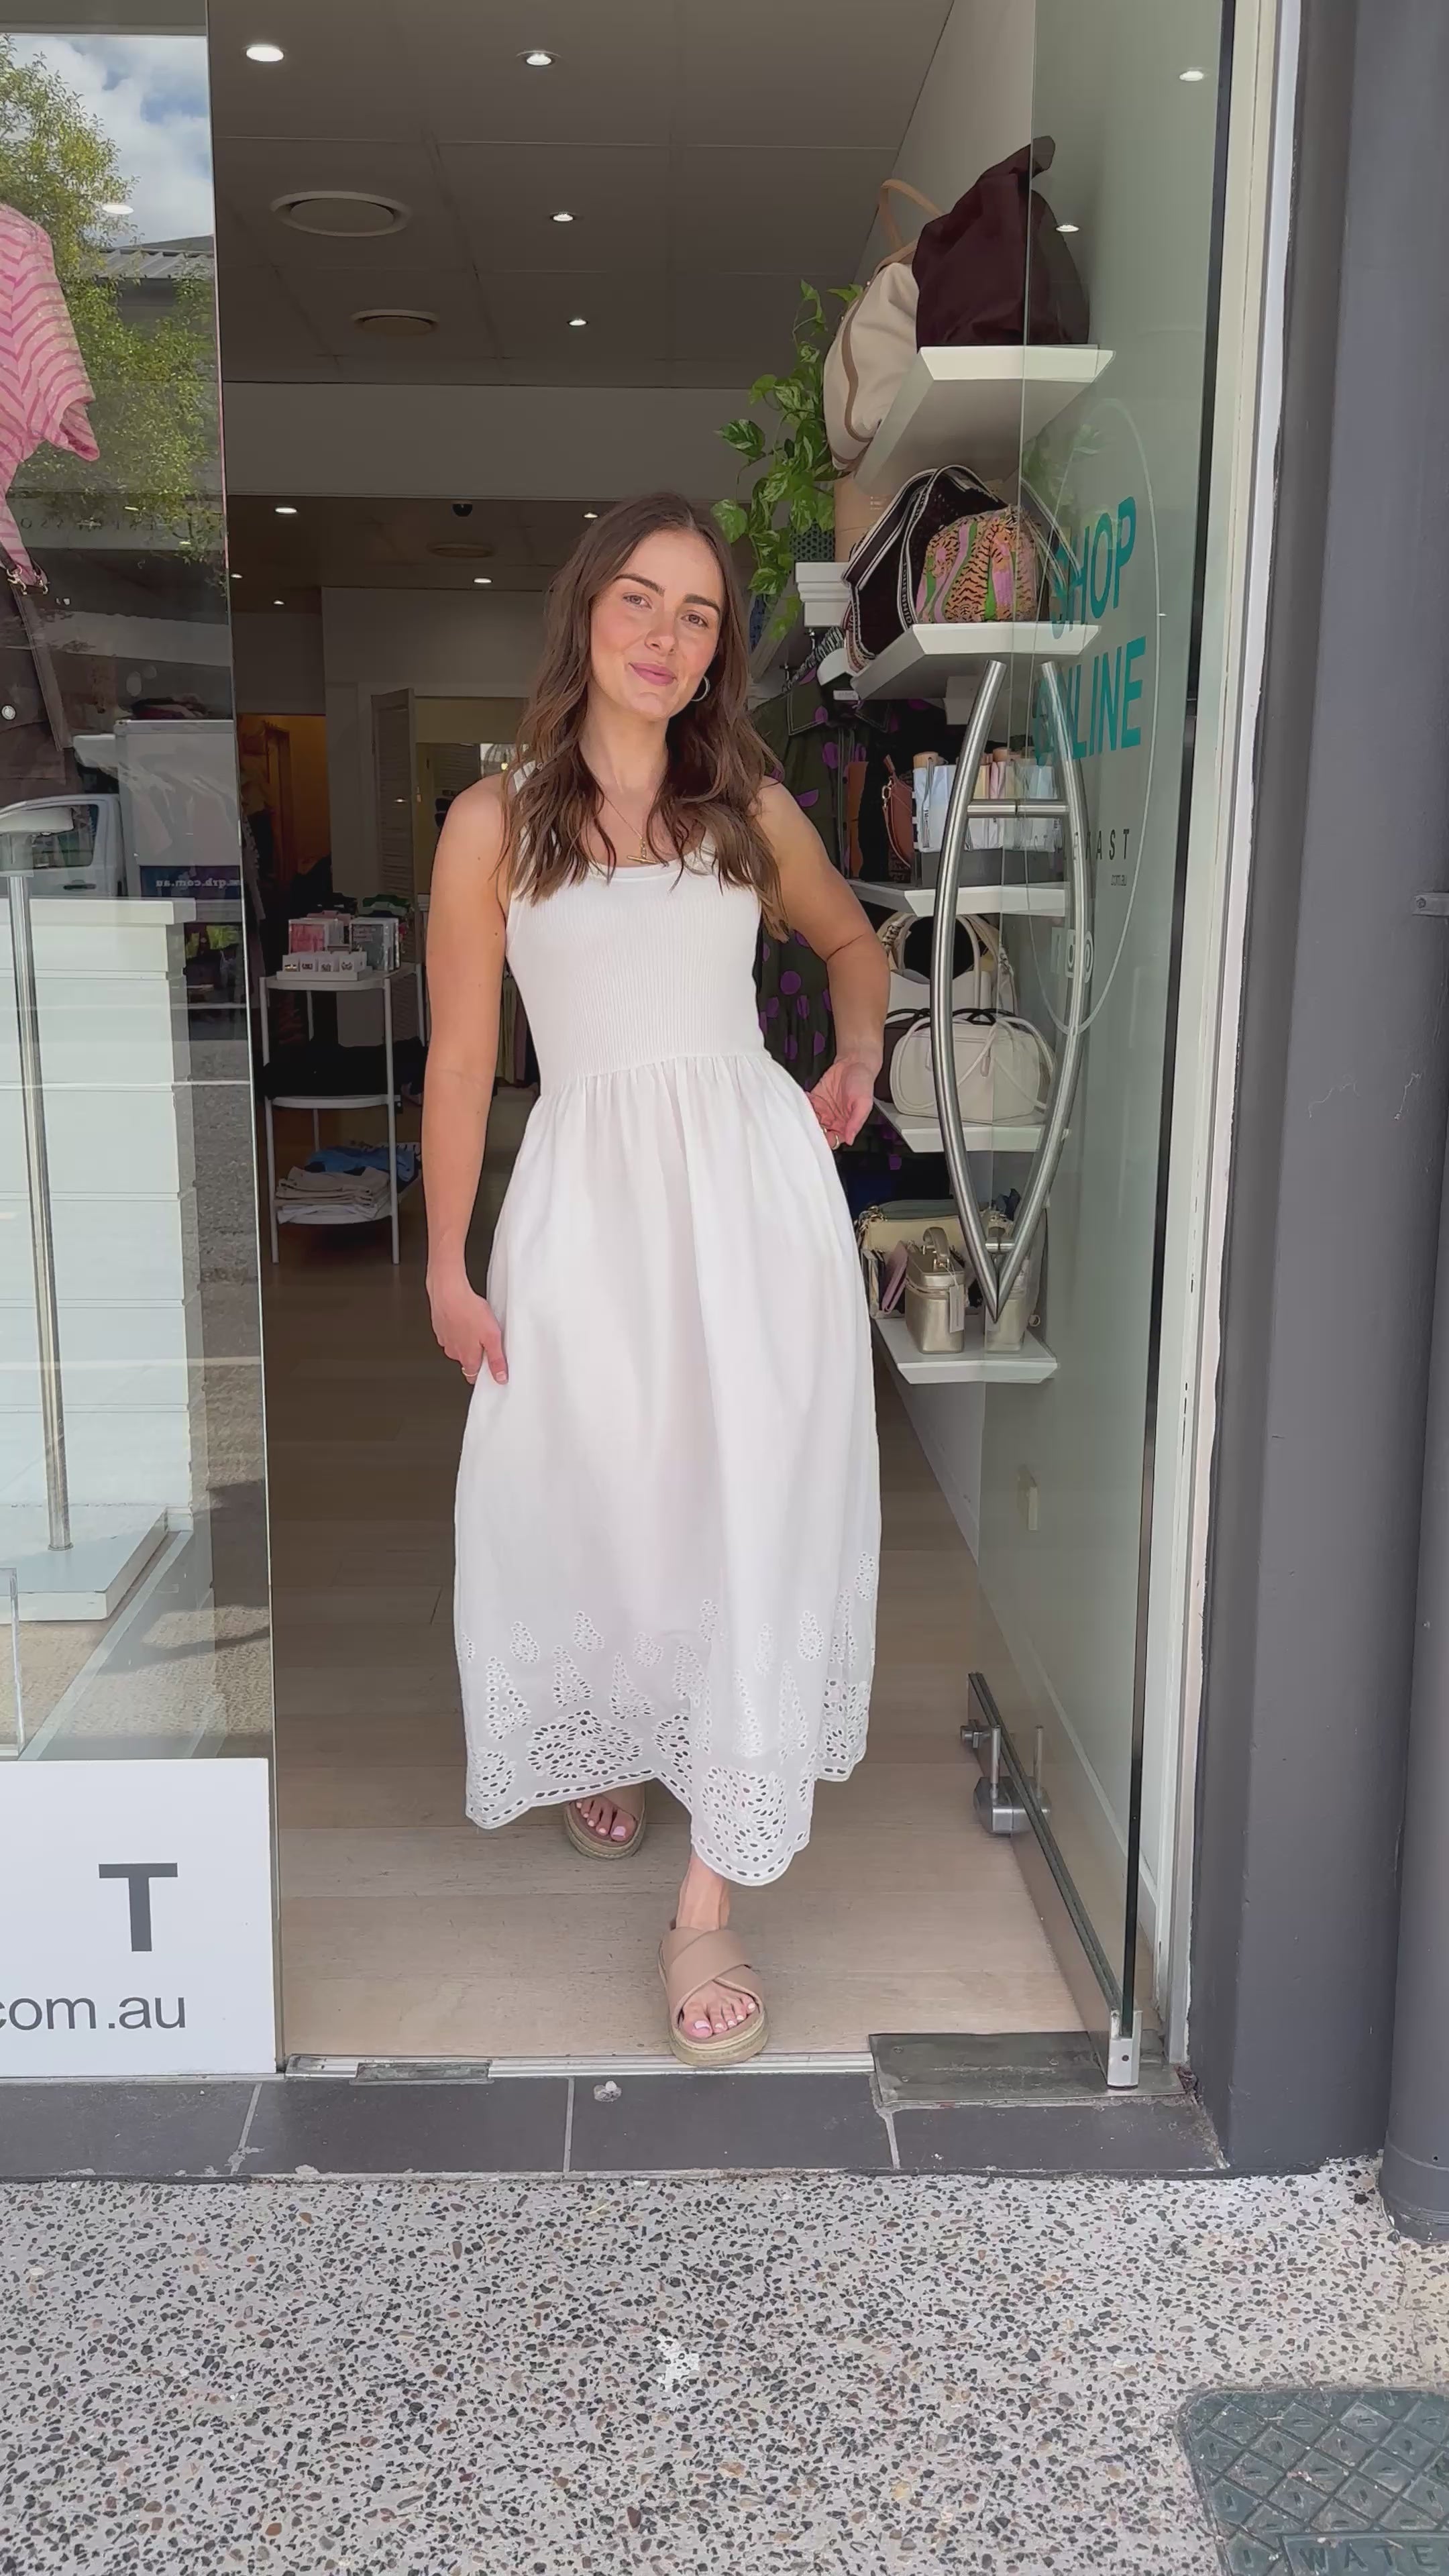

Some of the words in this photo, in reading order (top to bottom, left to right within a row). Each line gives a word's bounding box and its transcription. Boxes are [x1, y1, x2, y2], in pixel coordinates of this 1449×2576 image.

[1051, 496, 1136, 639] SHOP
[99, 1862, 178, 1951] T
[1297, 2539, 1449, 2571] WATE
